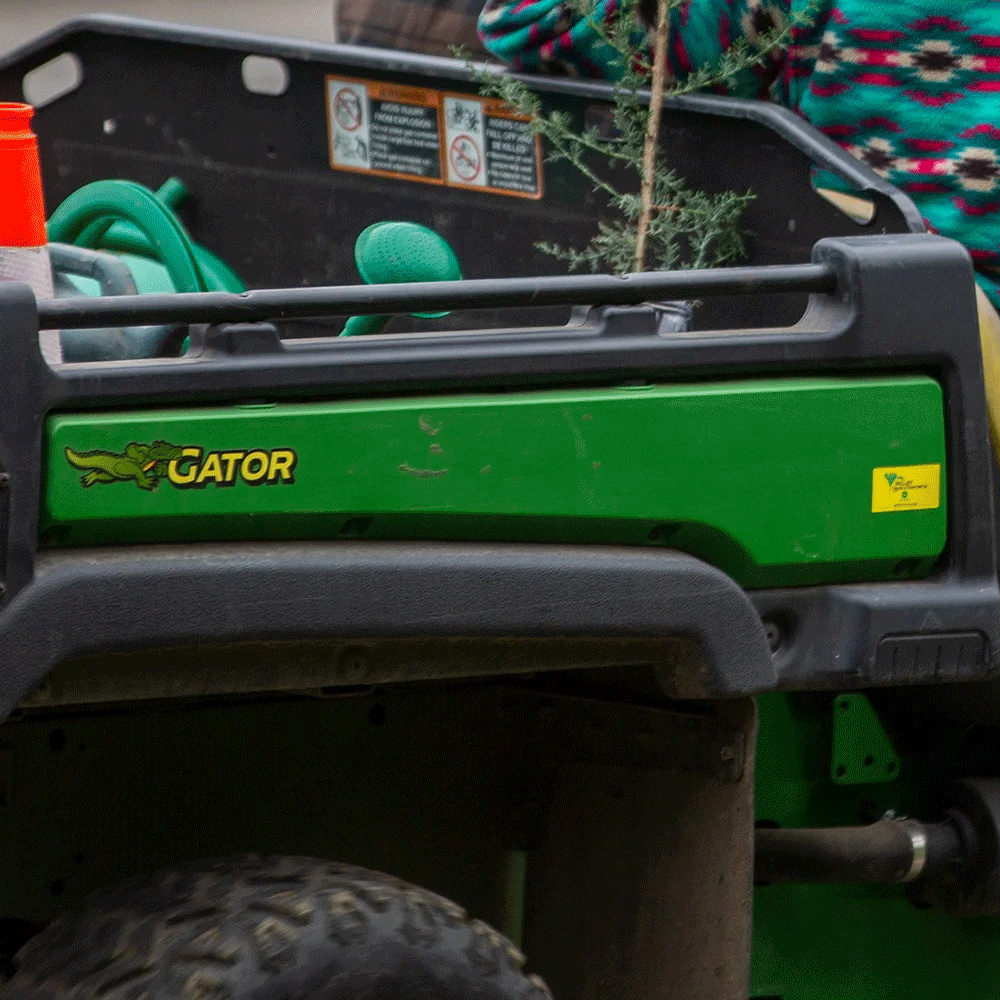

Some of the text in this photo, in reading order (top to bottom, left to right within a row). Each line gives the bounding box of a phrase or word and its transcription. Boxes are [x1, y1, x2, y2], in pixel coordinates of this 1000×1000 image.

[394, 115, 431, 129] EXPLOSION
[485, 128, 501, 139] FALL
[502, 142, 527, 154] KILLED
[167, 446, 296, 487] GATOR
